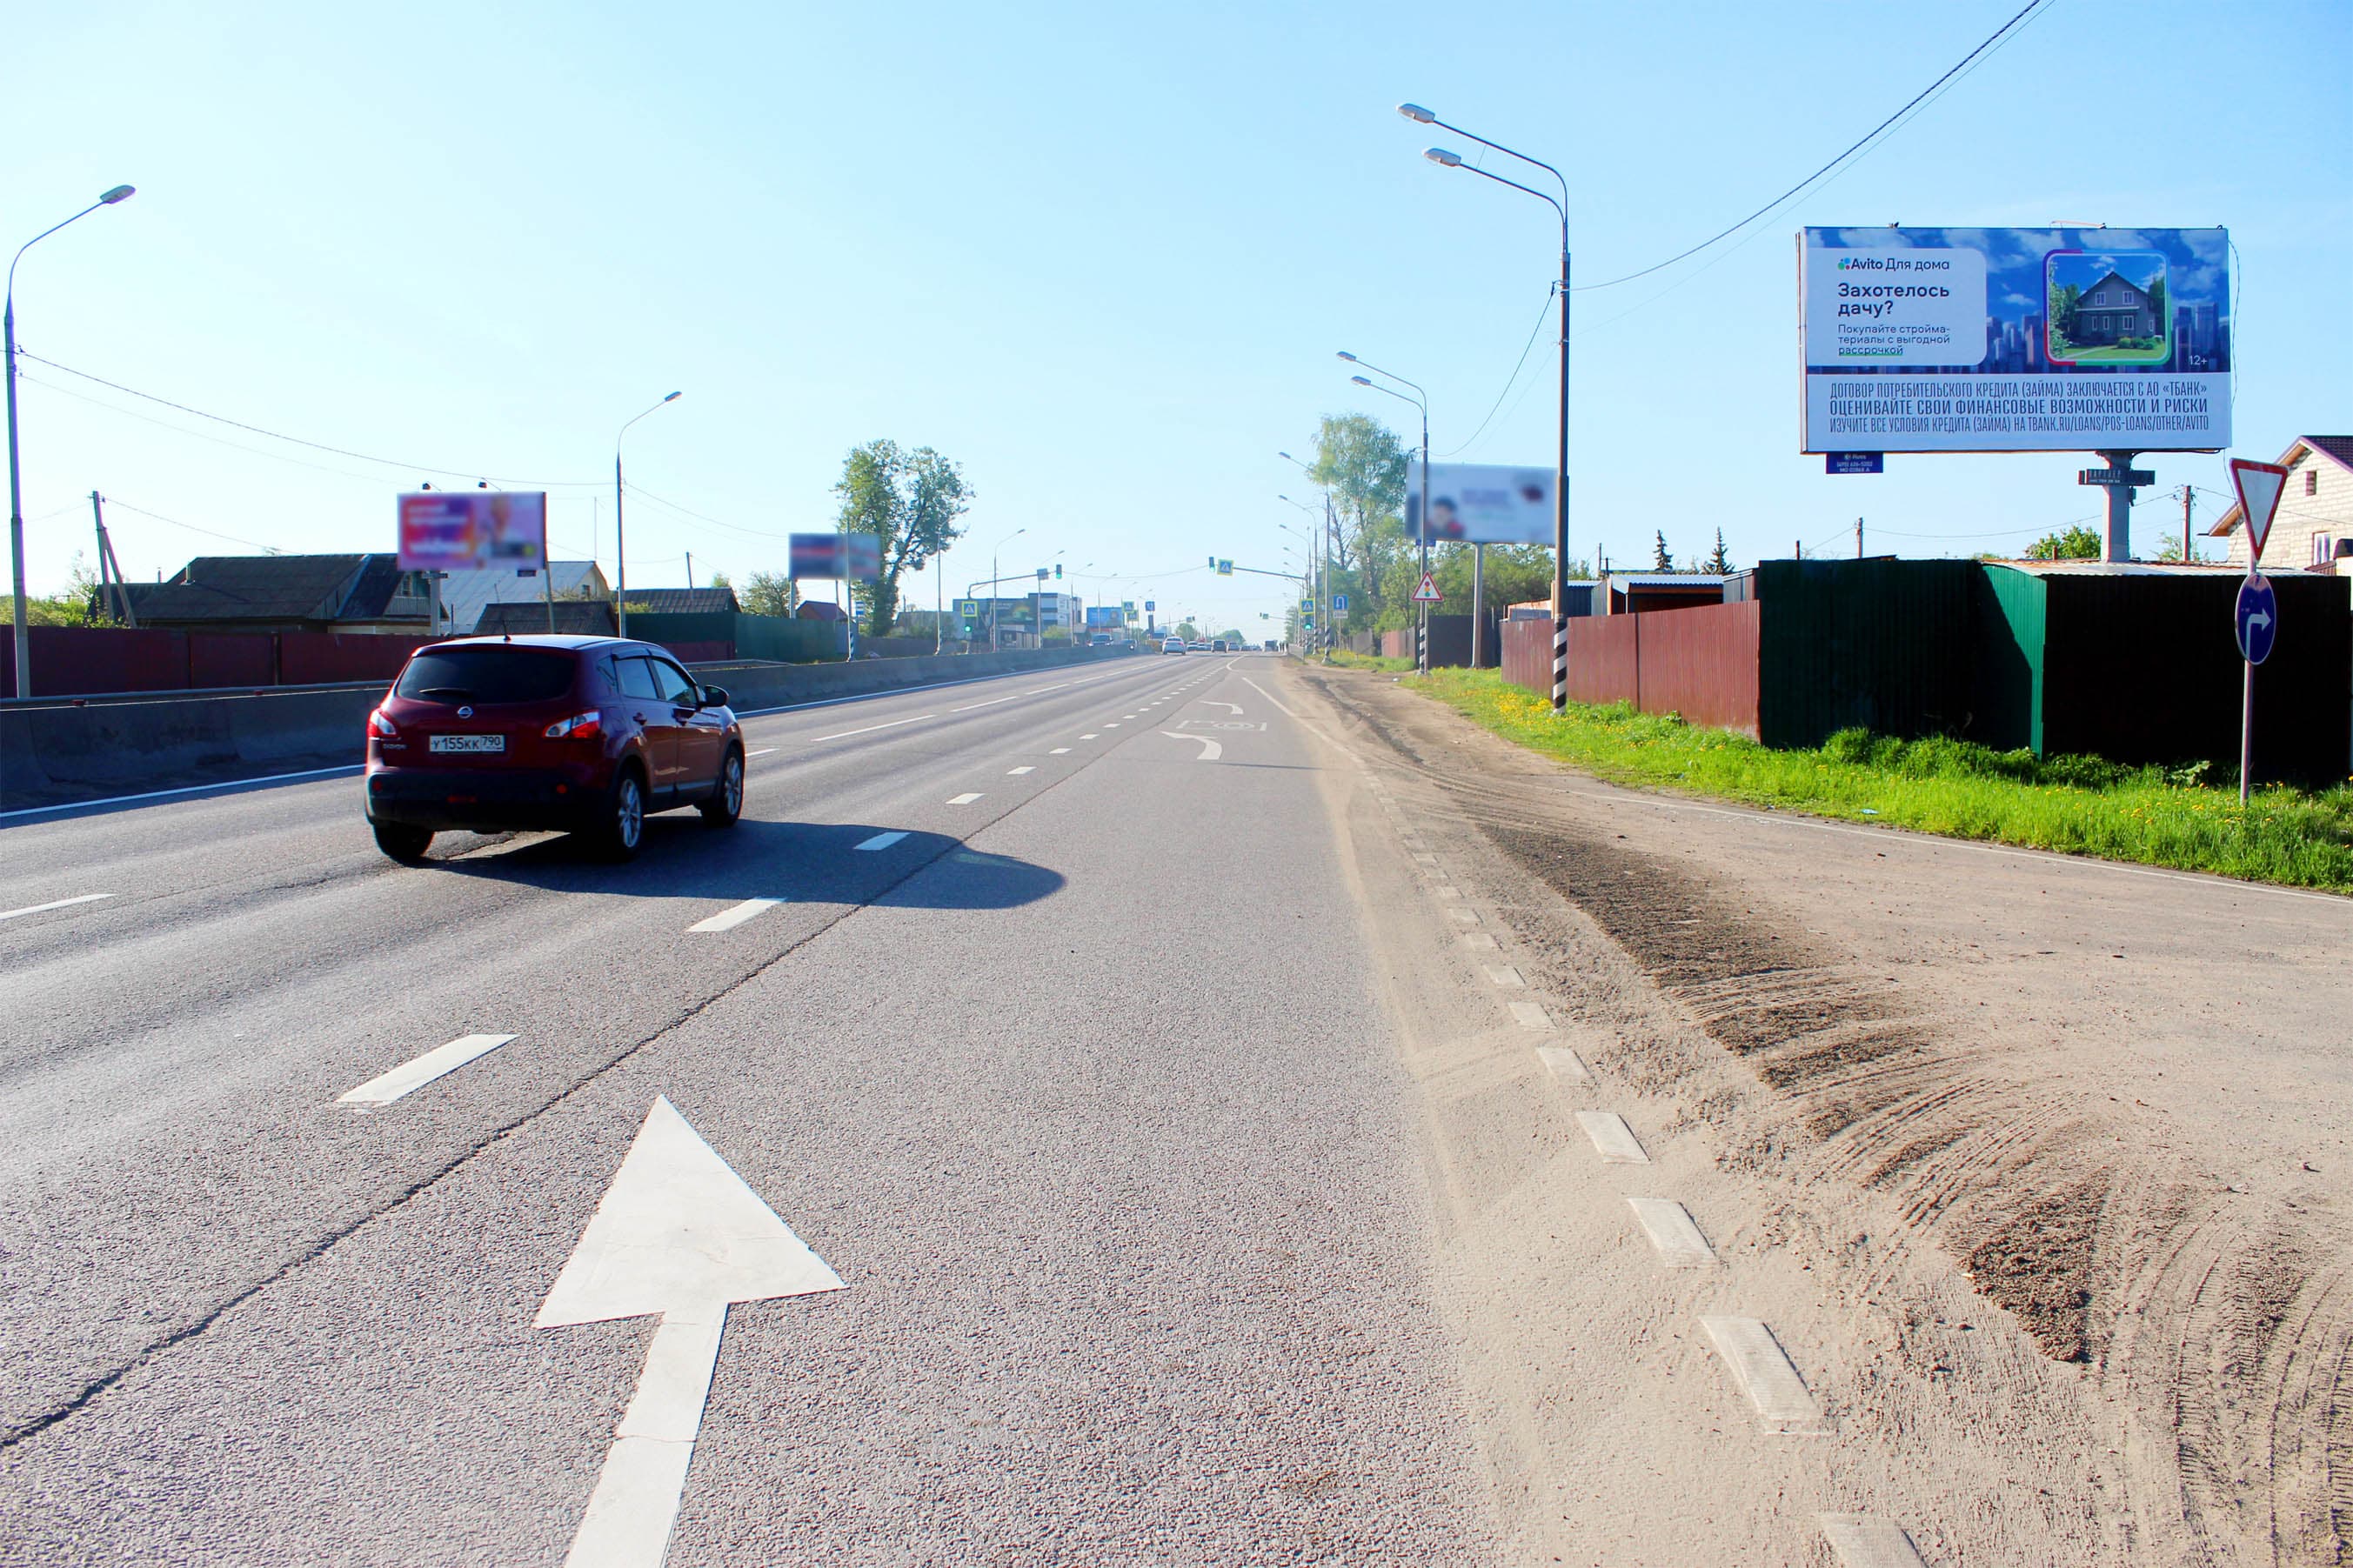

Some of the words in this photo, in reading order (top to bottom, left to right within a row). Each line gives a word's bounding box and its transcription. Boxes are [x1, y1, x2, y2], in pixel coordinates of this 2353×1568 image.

[1885, 257, 1911, 271] Для
[1915, 260, 1949, 271] дома
[1838, 283, 1949, 297] Захотелось
[1838, 300, 1893, 318] дачу?
[1838, 324, 1896, 335] Покупайте
[1899, 324, 1951, 335] стройма-
[1838, 337, 1884, 345] териалы
[1896, 335, 1950, 345] выгодной
[1838, 345, 1903, 356] рассрочкой
[2189, 356, 2208, 365] 12+
[1830, 383, 1874, 399] ДОГОВОР
[1877, 383, 1972, 398] ПОТРЕБИТЕЛЬСКОГО
[1976, 383, 2019, 398] КРЕДИТА
[2022, 380, 2063, 397] (ЗАЙМА)
[2067, 382, 2135, 397] ЗАКЛЮЧАЕТСЯ
[2138, 382, 2144, 397] С
[2147, 382, 2159, 397] АО
[2162, 381, 2207, 397] «ТБАНК»
[1830, 398, 1912, 417] ОЦЕНИВАЙТЕ
[1917, 400, 1950, 416] СВОИ
[1956, 399, 2045, 416] ФИНАНСОВЫЕ
[2050, 398, 2146, 415] ВОЗМОЖНОСТИ
[2151, 398, 2159, 414] И
[2164, 398, 2207, 414] РИСКИ
[1830, 417, 1868, 433] ИЗУЧИТЕ
[1871, 417, 1886, 433] ВСЕ
[1889, 417, 1929, 433] УСЛОВИЯ
[1933, 417, 1970, 434] КРЕДИТА
[1973, 415, 2010, 433] (ЗАЙМА)
[2014, 417, 2025, 432] НА
[2029, 415, 2209, 432] TBANK.RU/LOANS/POS-LOANS/OTHER/AVITO
